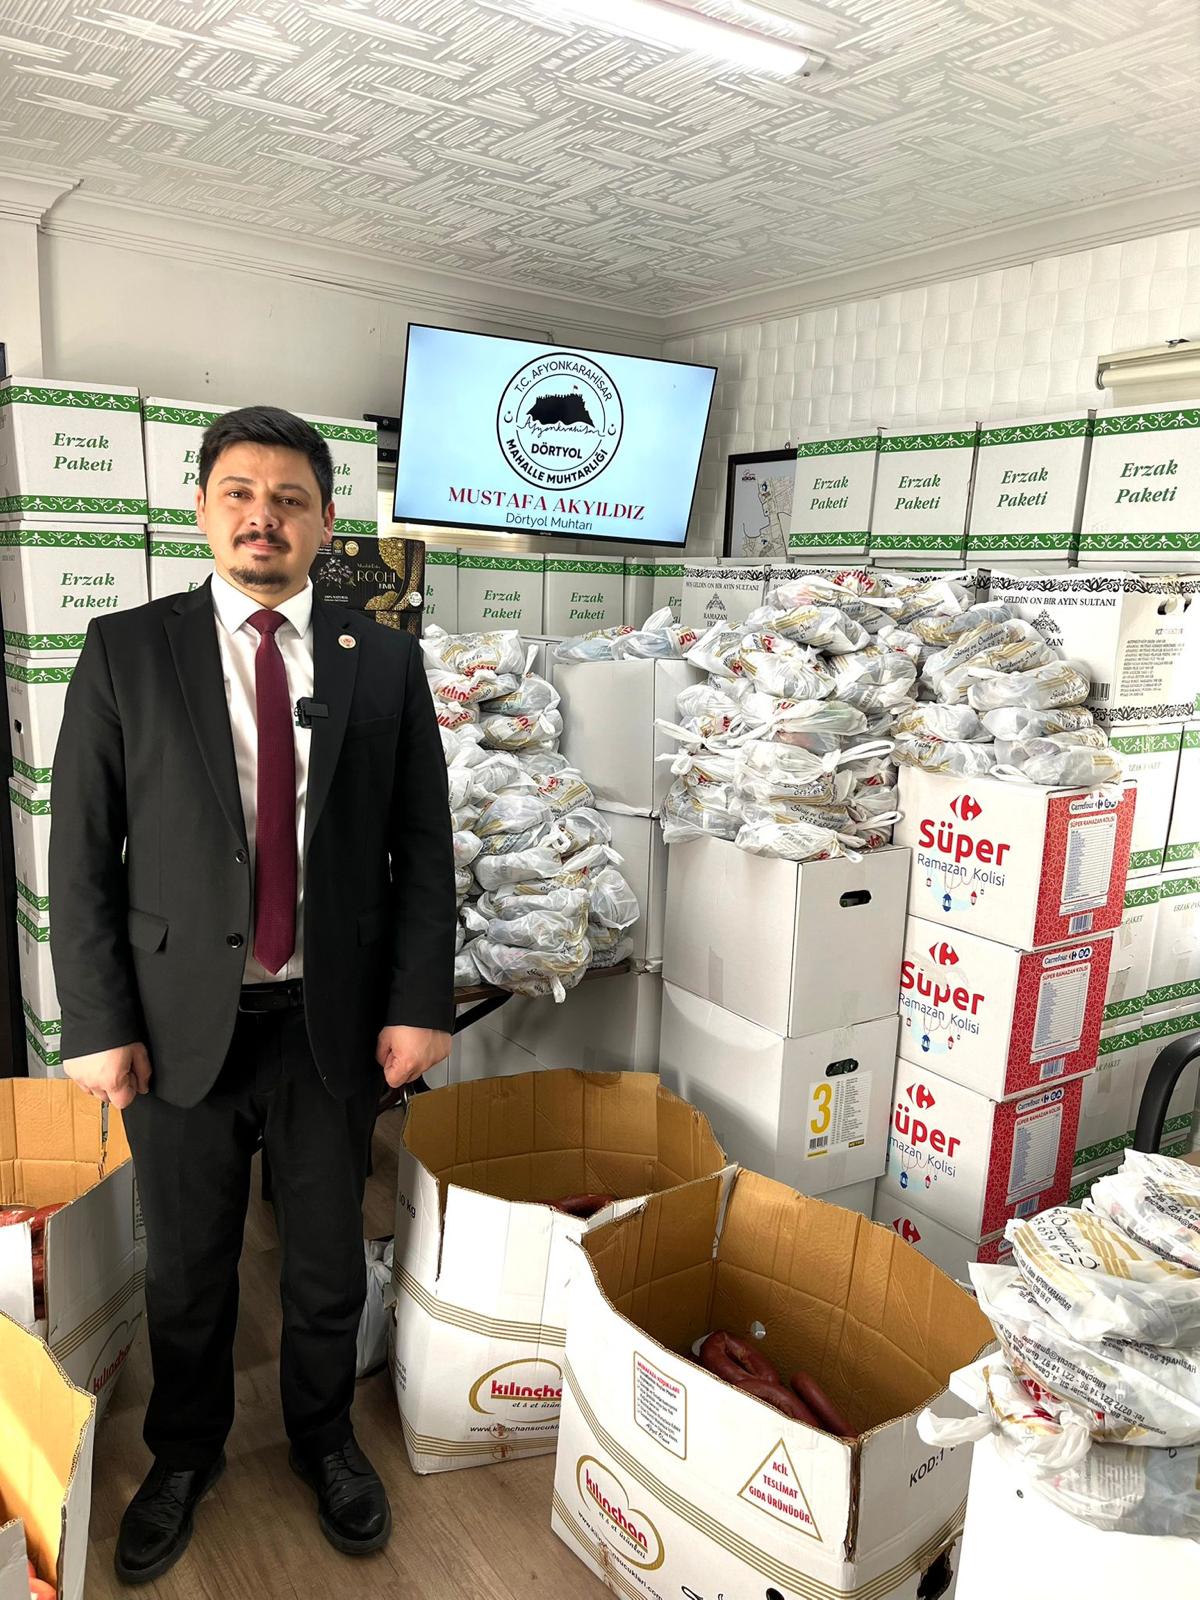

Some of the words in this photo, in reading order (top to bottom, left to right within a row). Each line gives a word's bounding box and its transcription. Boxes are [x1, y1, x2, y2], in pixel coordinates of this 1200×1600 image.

[514, 377, 532, 393] T.C.
[532, 361, 613, 401] AFYONKARAHİSAR
[53, 432, 110, 450] Erzak
[531, 442, 583, 459] DÖRTYOL
[54, 455, 113, 473] Paketi
[506, 439, 546, 481] MAHALLE
[1001, 467, 1048, 484] Erzak
[1120, 459, 1179, 479] Erzak
[812, 475, 849, 490] Erzak
[898, 473, 941, 490] Erzak
[449, 486, 547, 510] MUSTAFA
[553, 497, 646, 520] AKYILDIZ
[895, 496, 941, 510] Paketi
[997, 491, 1048, 508] Paketi
[1115, 485, 1178, 505] Paketi
[810, 497, 849, 511] Paketi
[506, 512, 548, 528] Dörtyol
[550, 516, 593, 530] Muhtarı
[61, 573, 115, 586] Erzak
[61, 595, 119, 608] Paketi
[484, 589, 521, 602] Erzak
[570, 592, 603, 603] Erzak
[1080, 598, 1116, 607] SULTANI
[483, 607, 522, 619] Paketi
[569, 608, 605, 620] Paketi
[918, 818, 1011, 865] Süper
[917, 853, 967, 877] Ramazan
[973, 867, 1005, 887] Kolisi
[899, 992, 945, 1021] Ramazan
[950, 1012, 981, 1035] Kolisi
[811, 1083, 833, 1134] 3
[891, 1102, 961, 1158] üper
[890, 1136, 922, 1161] mazan
[927, 1153, 957, 1178] Kolisi
[1062, 1370, 1076, 1381] 221
[491, 1380, 563, 1400] kılınçha
[1089, 1389, 1098, 1397] 14
[1100, 1396, 1114, 1406] 221
[1114, 1401, 1133, 1415] 0272
[772, 1461, 788, 1477] ACİL
[763, 1474, 798, 1499] TESLİMAT
[749, 1485, 766, 1502] GIDA
[767, 1493, 813, 1525] ÜRÜNÜDÜR.
